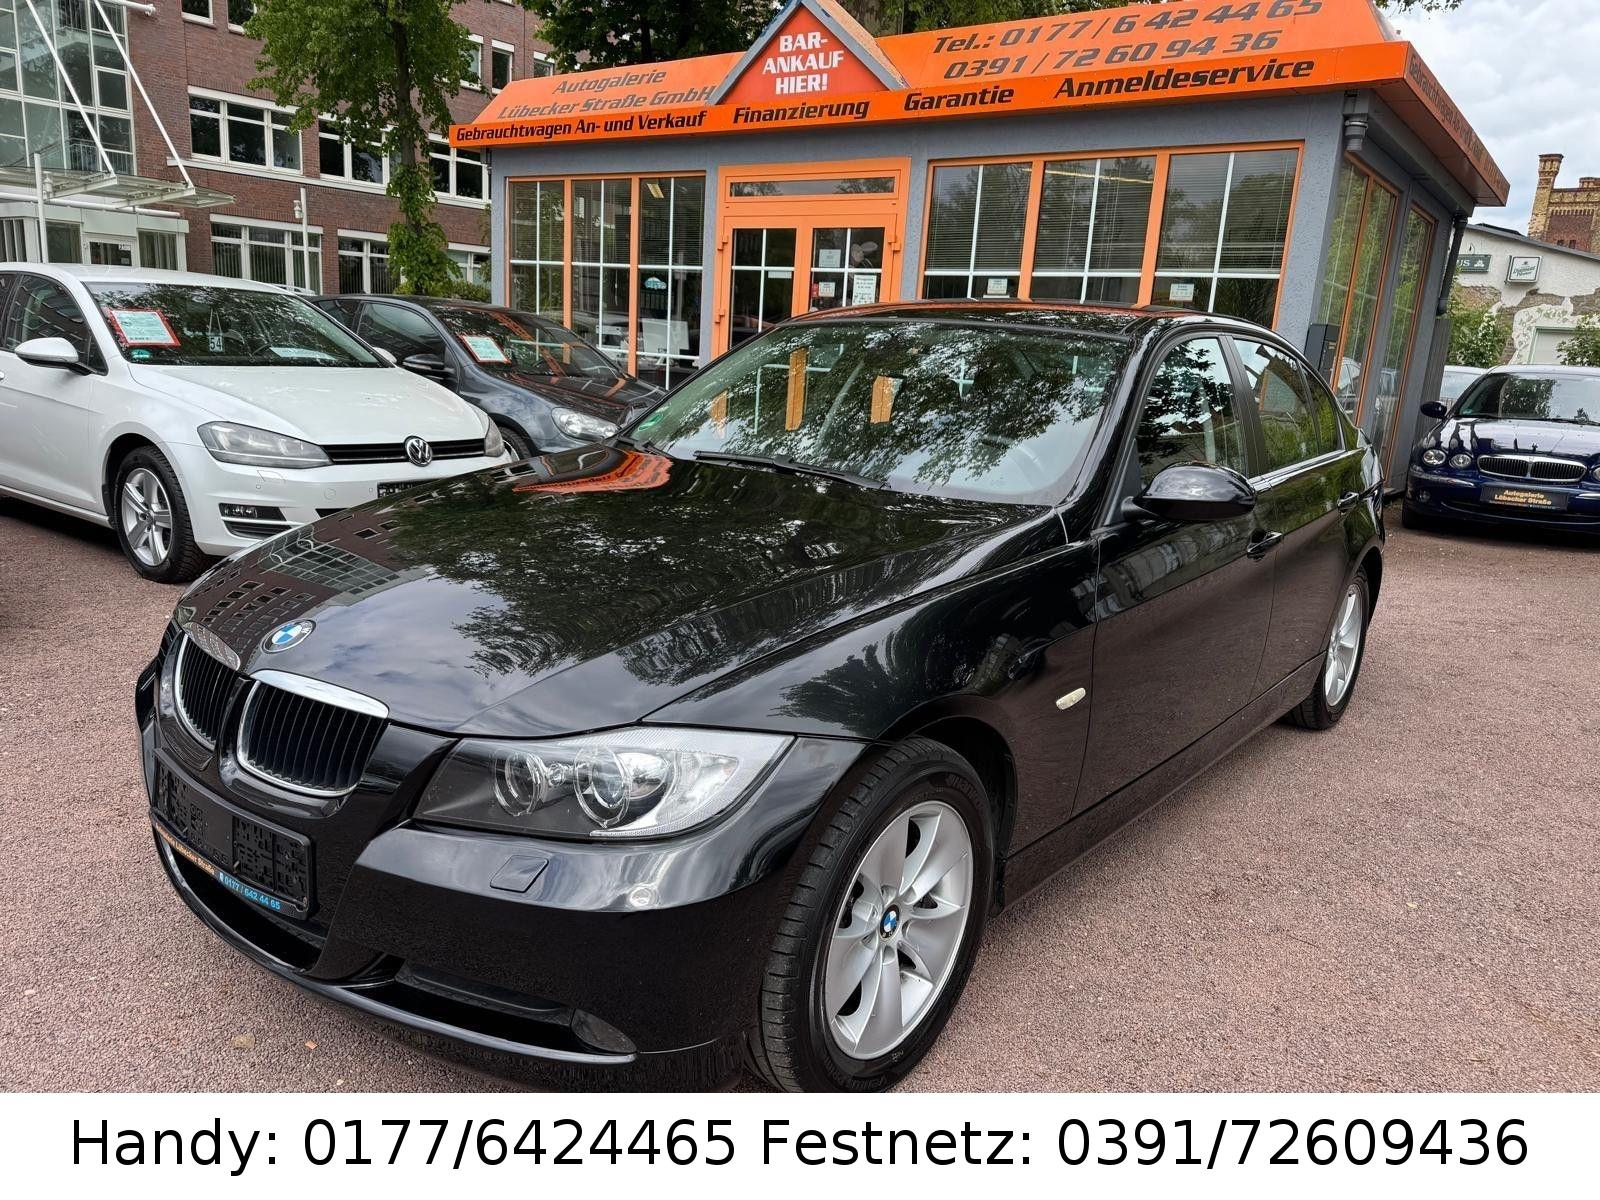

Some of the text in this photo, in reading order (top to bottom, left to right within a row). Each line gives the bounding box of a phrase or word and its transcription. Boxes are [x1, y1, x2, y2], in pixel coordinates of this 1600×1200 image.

[779, 31, 828, 53] BAR-
[933, 33, 995, 53] Tel.:
[999, 20, 1093, 46] 0177
[762, 50, 844, 75] ANKAUF
[944, 55, 1028, 79] 0391
[551, 69, 667, 95] Autogalerie
[775, 73, 828, 95] HIER!
[1053, 58, 1315, 99] Anmeldeservice
[497, 85, 717, 120] Lübecker Straße GmbH
[904, 85, 1015, 112] Garantie
[733, 101, 870, 124] Finanzierung
[456, 110, 708, 142] Gebrauchtwagen An- und Verkauf
[210, 336, 222, 350] 54
